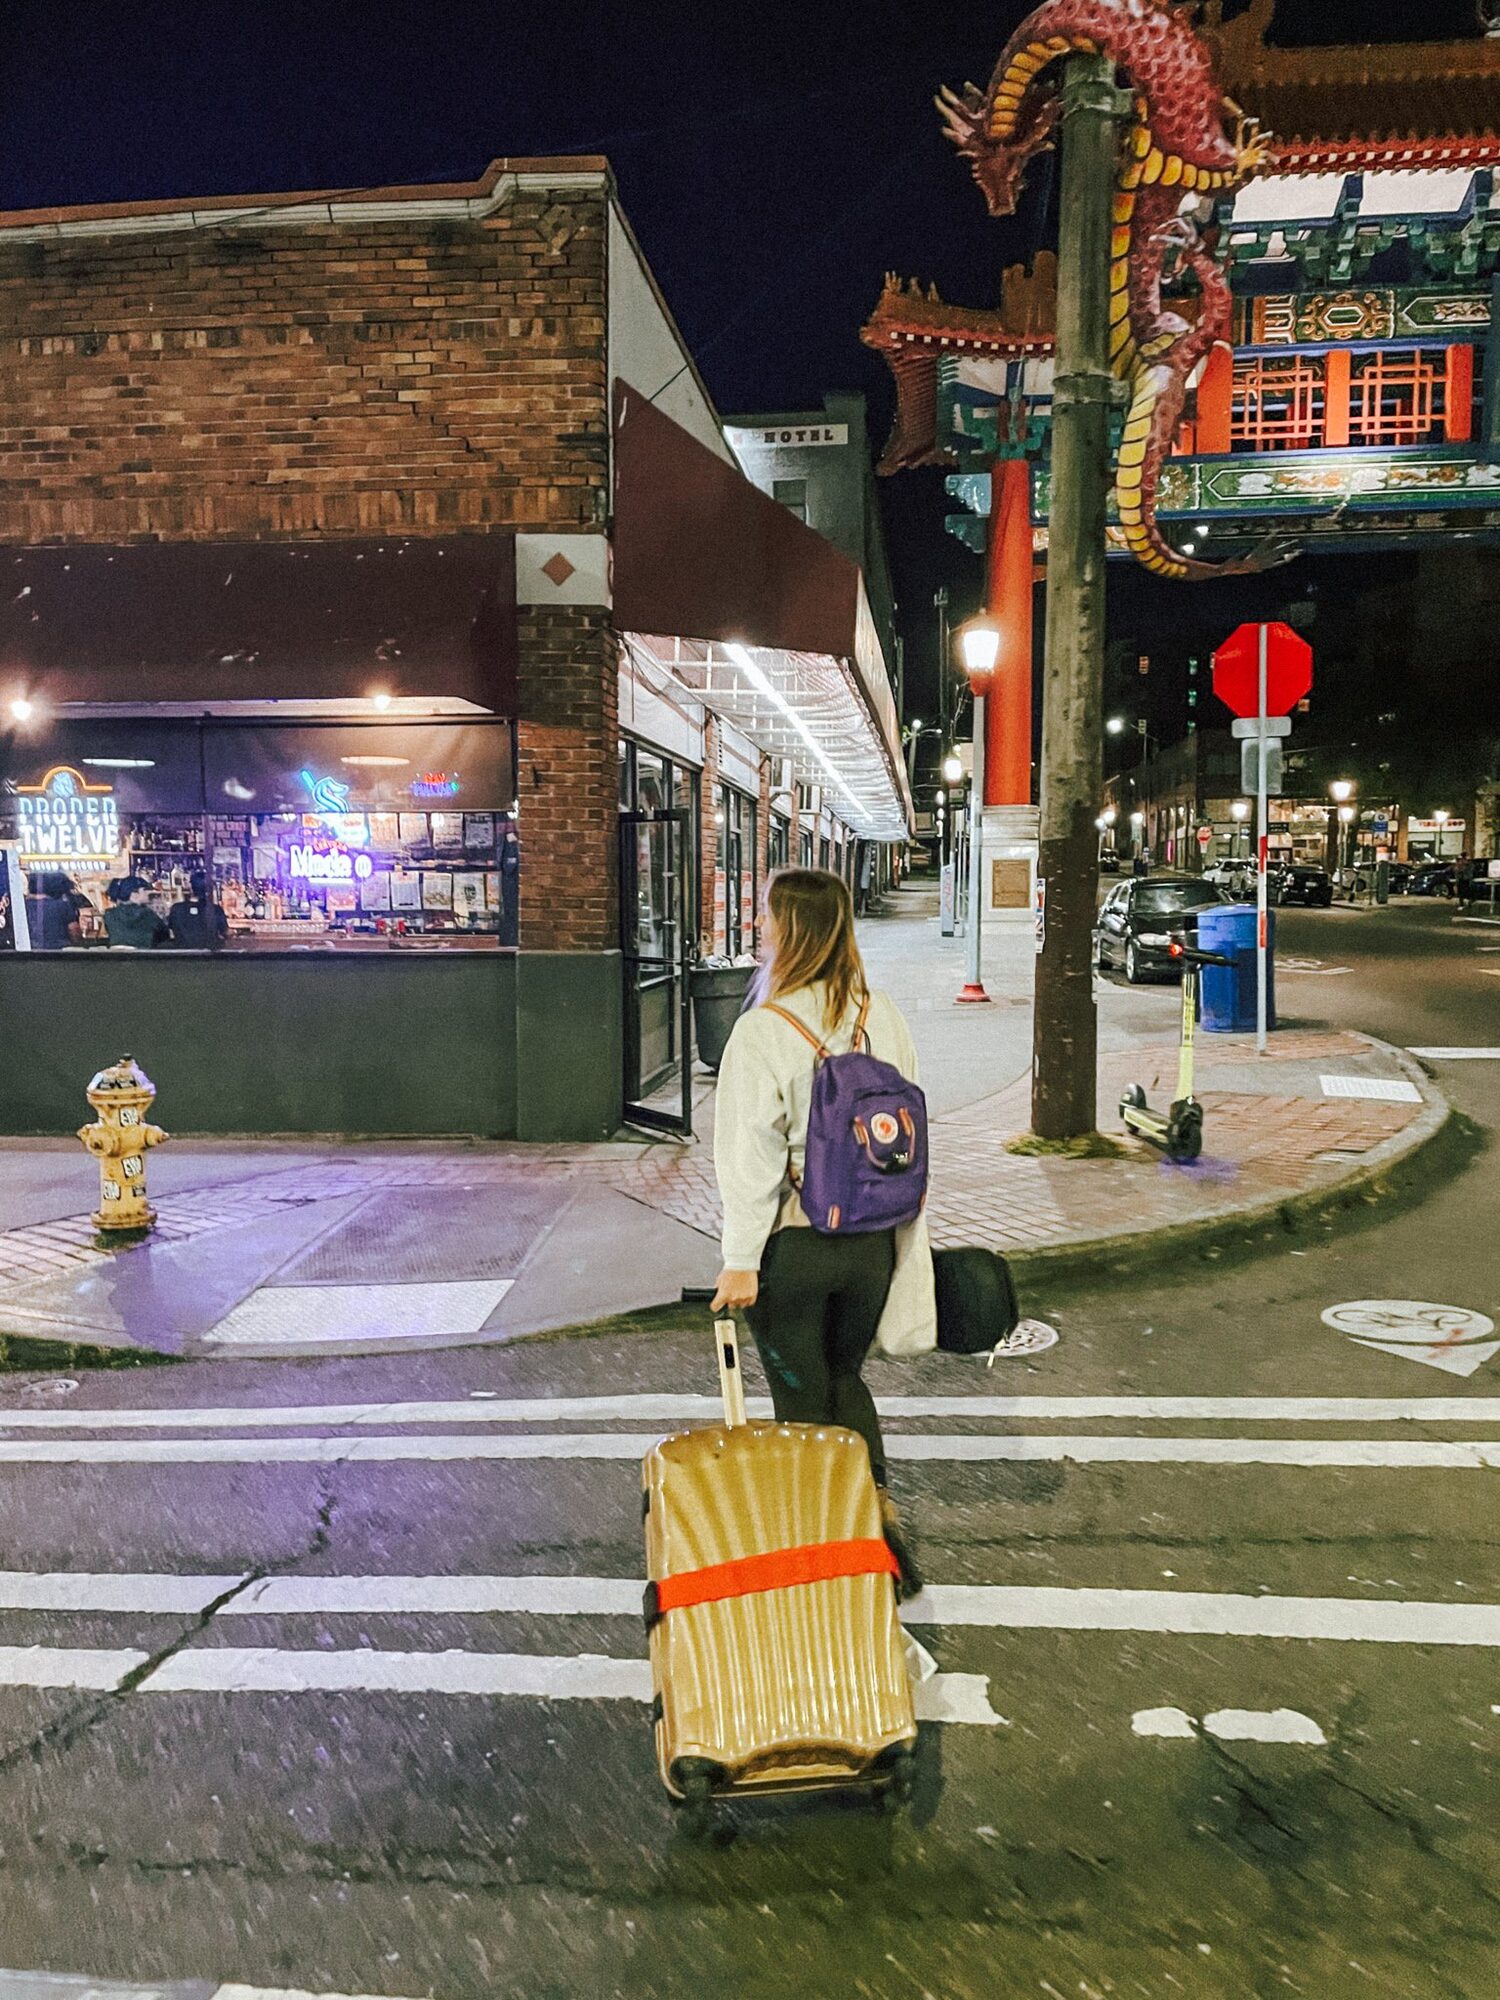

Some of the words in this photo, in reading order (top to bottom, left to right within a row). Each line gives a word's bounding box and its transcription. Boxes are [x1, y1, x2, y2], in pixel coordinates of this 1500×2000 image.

[764, 429, 833, 443] HOTEL
[18, 797, 118, 826] PROPER
[18, 825, 119, 854] TWELVE
